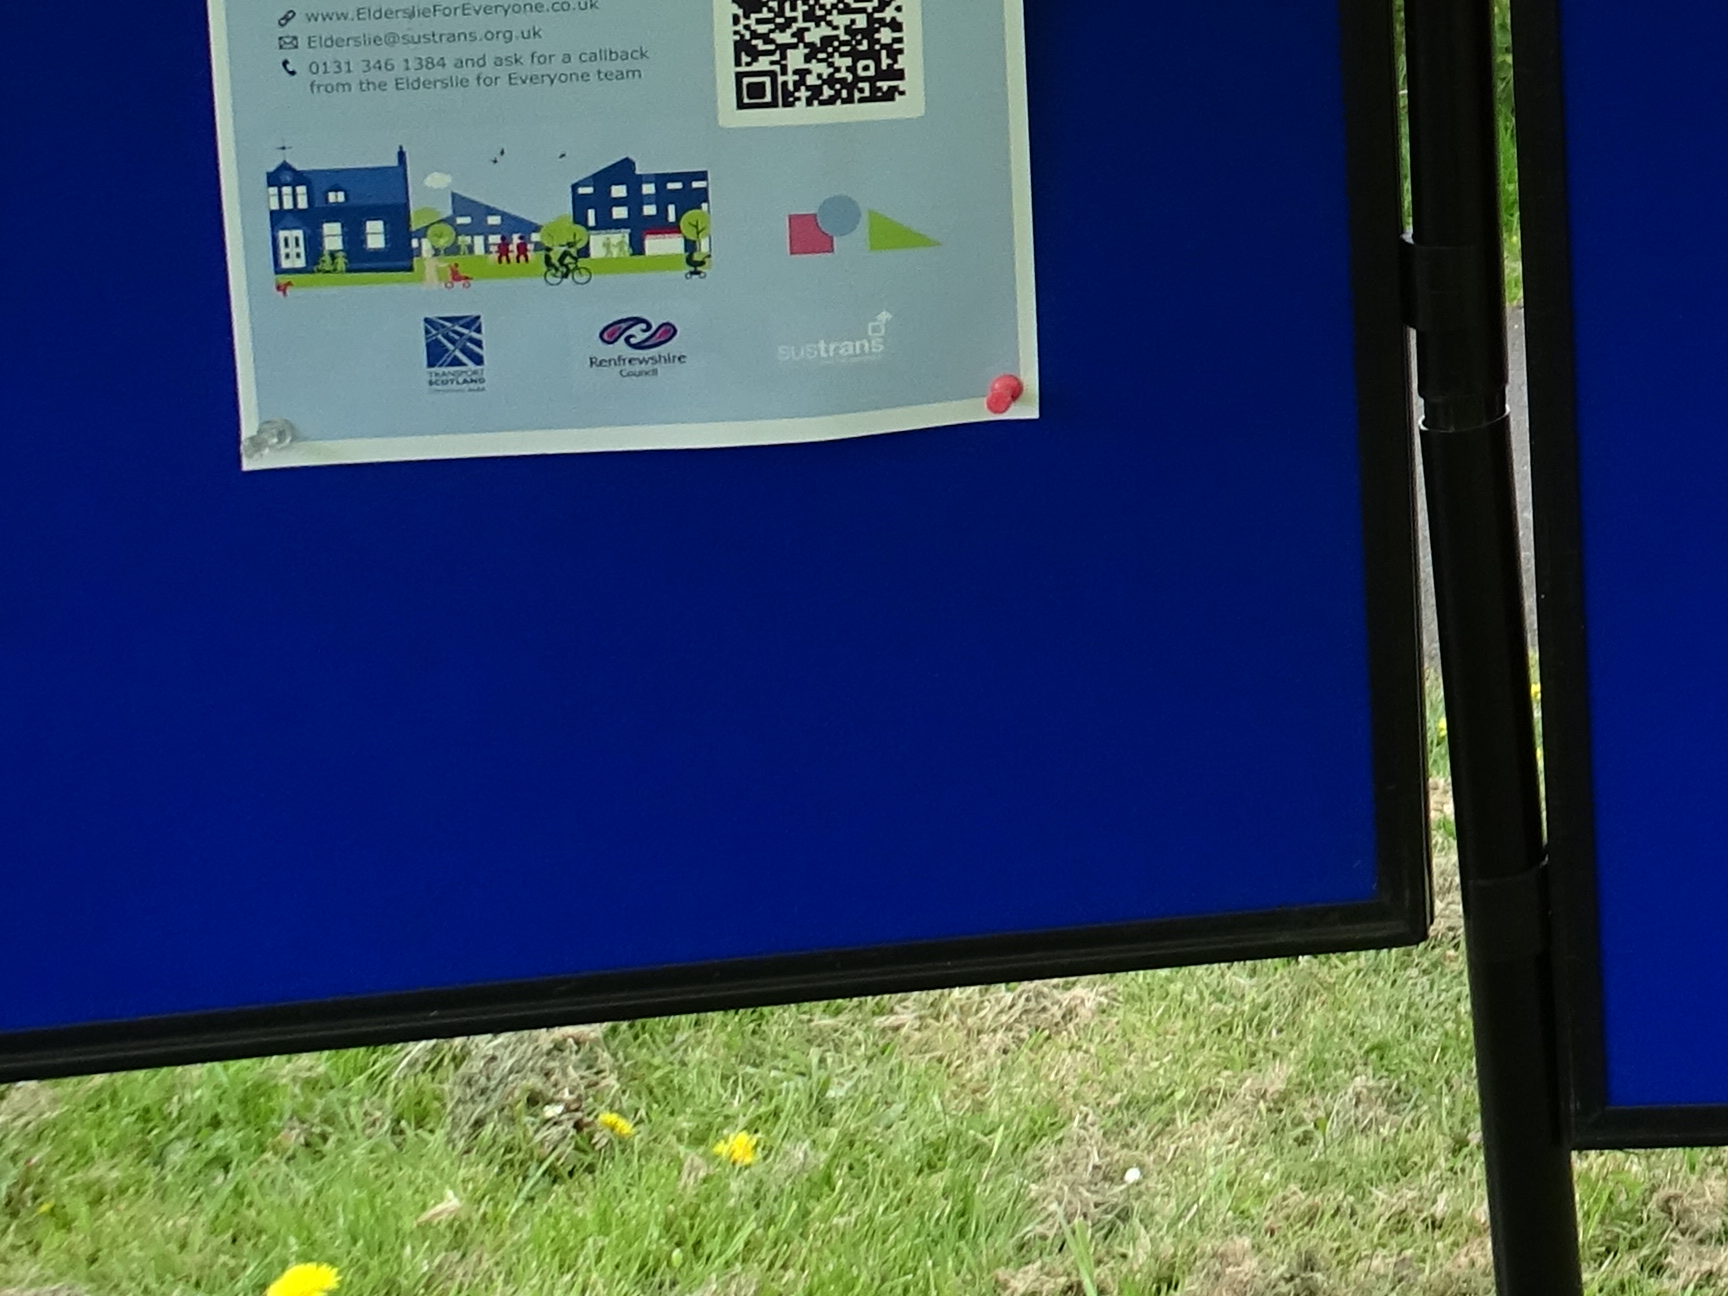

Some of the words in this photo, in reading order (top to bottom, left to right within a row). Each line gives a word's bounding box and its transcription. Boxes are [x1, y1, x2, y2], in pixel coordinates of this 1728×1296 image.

[307, 25, 543, 50] Elderslie@sustrans.org.uk
[588, 352, 687, 369] Renfrewshire
[777, 335, 885, 362] sustrans
